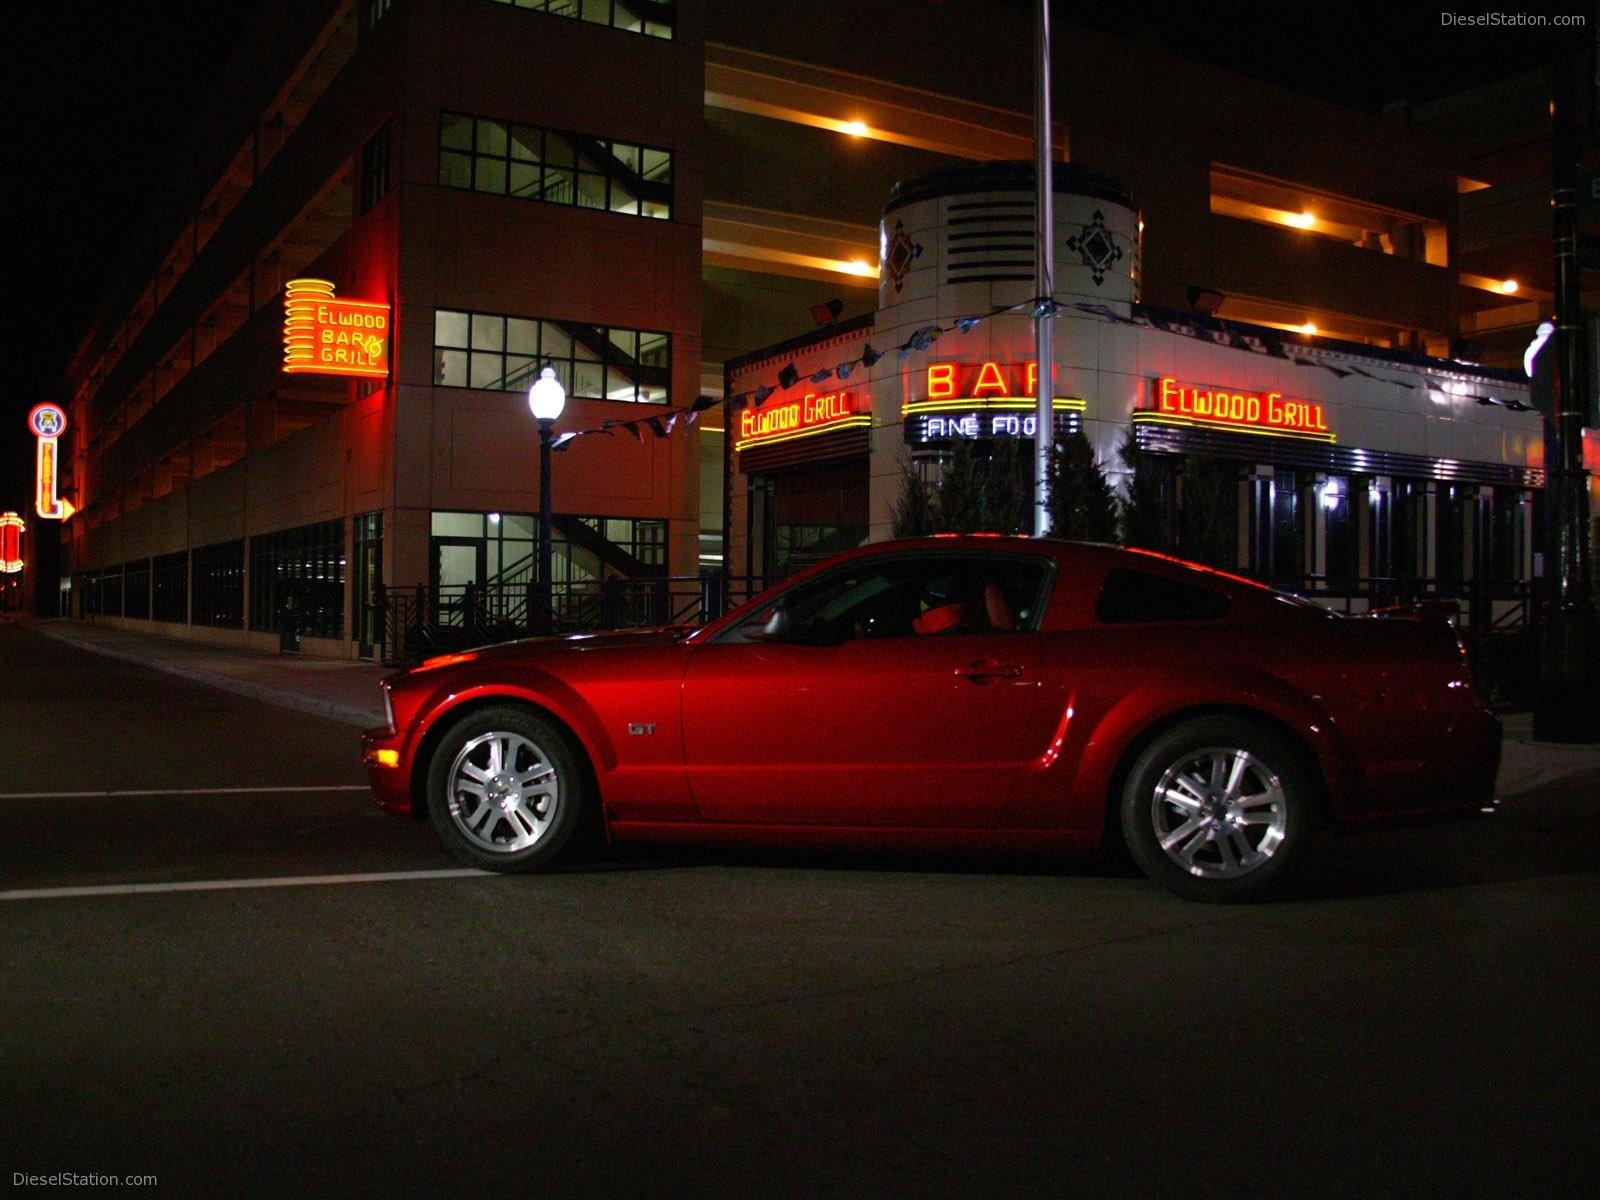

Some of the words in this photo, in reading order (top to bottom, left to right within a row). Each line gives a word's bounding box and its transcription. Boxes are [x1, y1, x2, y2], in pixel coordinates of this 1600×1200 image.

[317, 306, 386, 329] ELWOOD
[321, 329, 364, 347] BAR
[321, 347, 377, 366] GRILL
[1161, 377, 1261, 422] ELWOOD
[1267, 393, 1328, 430] GRILL
[741, 404, 800, 438] ELWOOD
[803, 392, 850, 423] GRILL
[927, 417, 978, 437] FINE
[628, 722, 656, 736] GT
